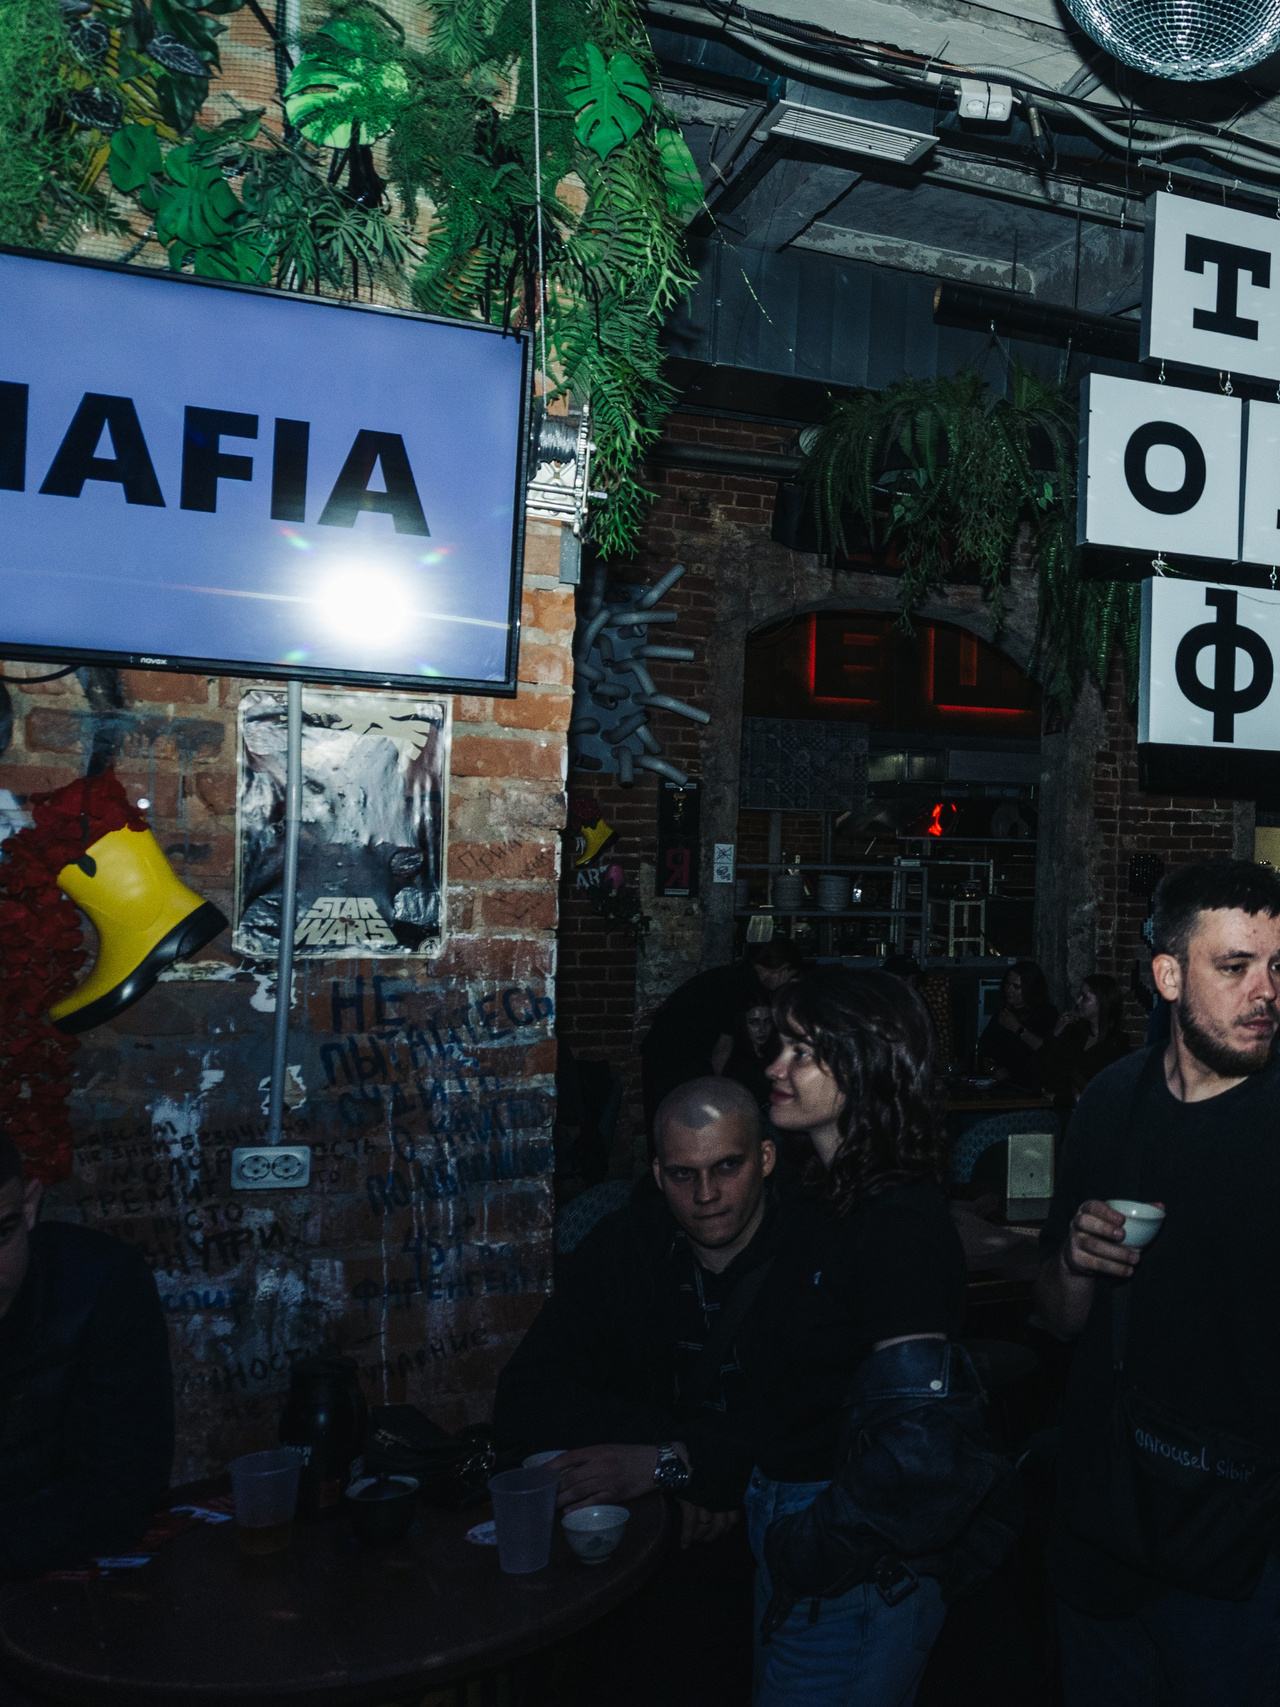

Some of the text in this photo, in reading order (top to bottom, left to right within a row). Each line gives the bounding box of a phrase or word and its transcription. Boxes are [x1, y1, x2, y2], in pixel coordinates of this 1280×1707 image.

[305, 897, 384, 919] STAR
[294, 919, 398, 946] WARS
[331, 975, 405, 1034] НЕ
